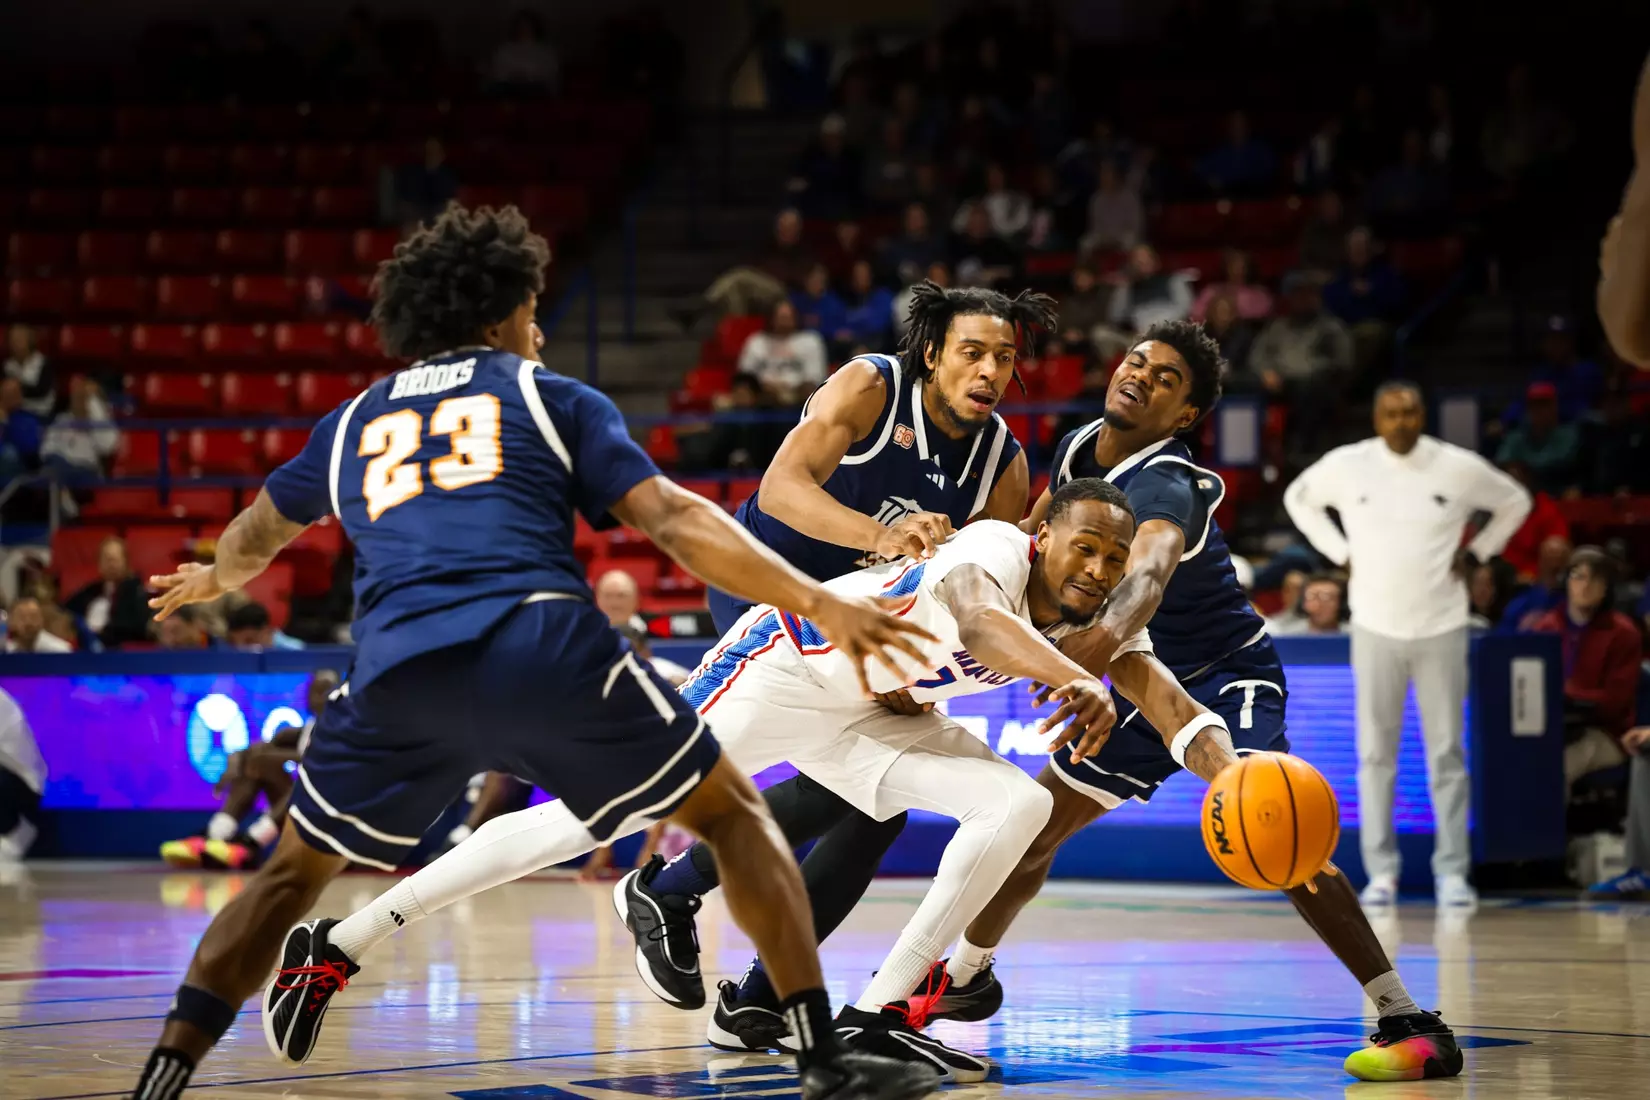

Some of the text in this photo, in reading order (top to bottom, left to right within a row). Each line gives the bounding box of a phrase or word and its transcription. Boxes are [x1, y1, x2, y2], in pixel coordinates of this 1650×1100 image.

[388, 357, 477, 400] BROOKS
[358, 393, 504, 523] 23
[1211, 790, 1235, 856] NCAA
